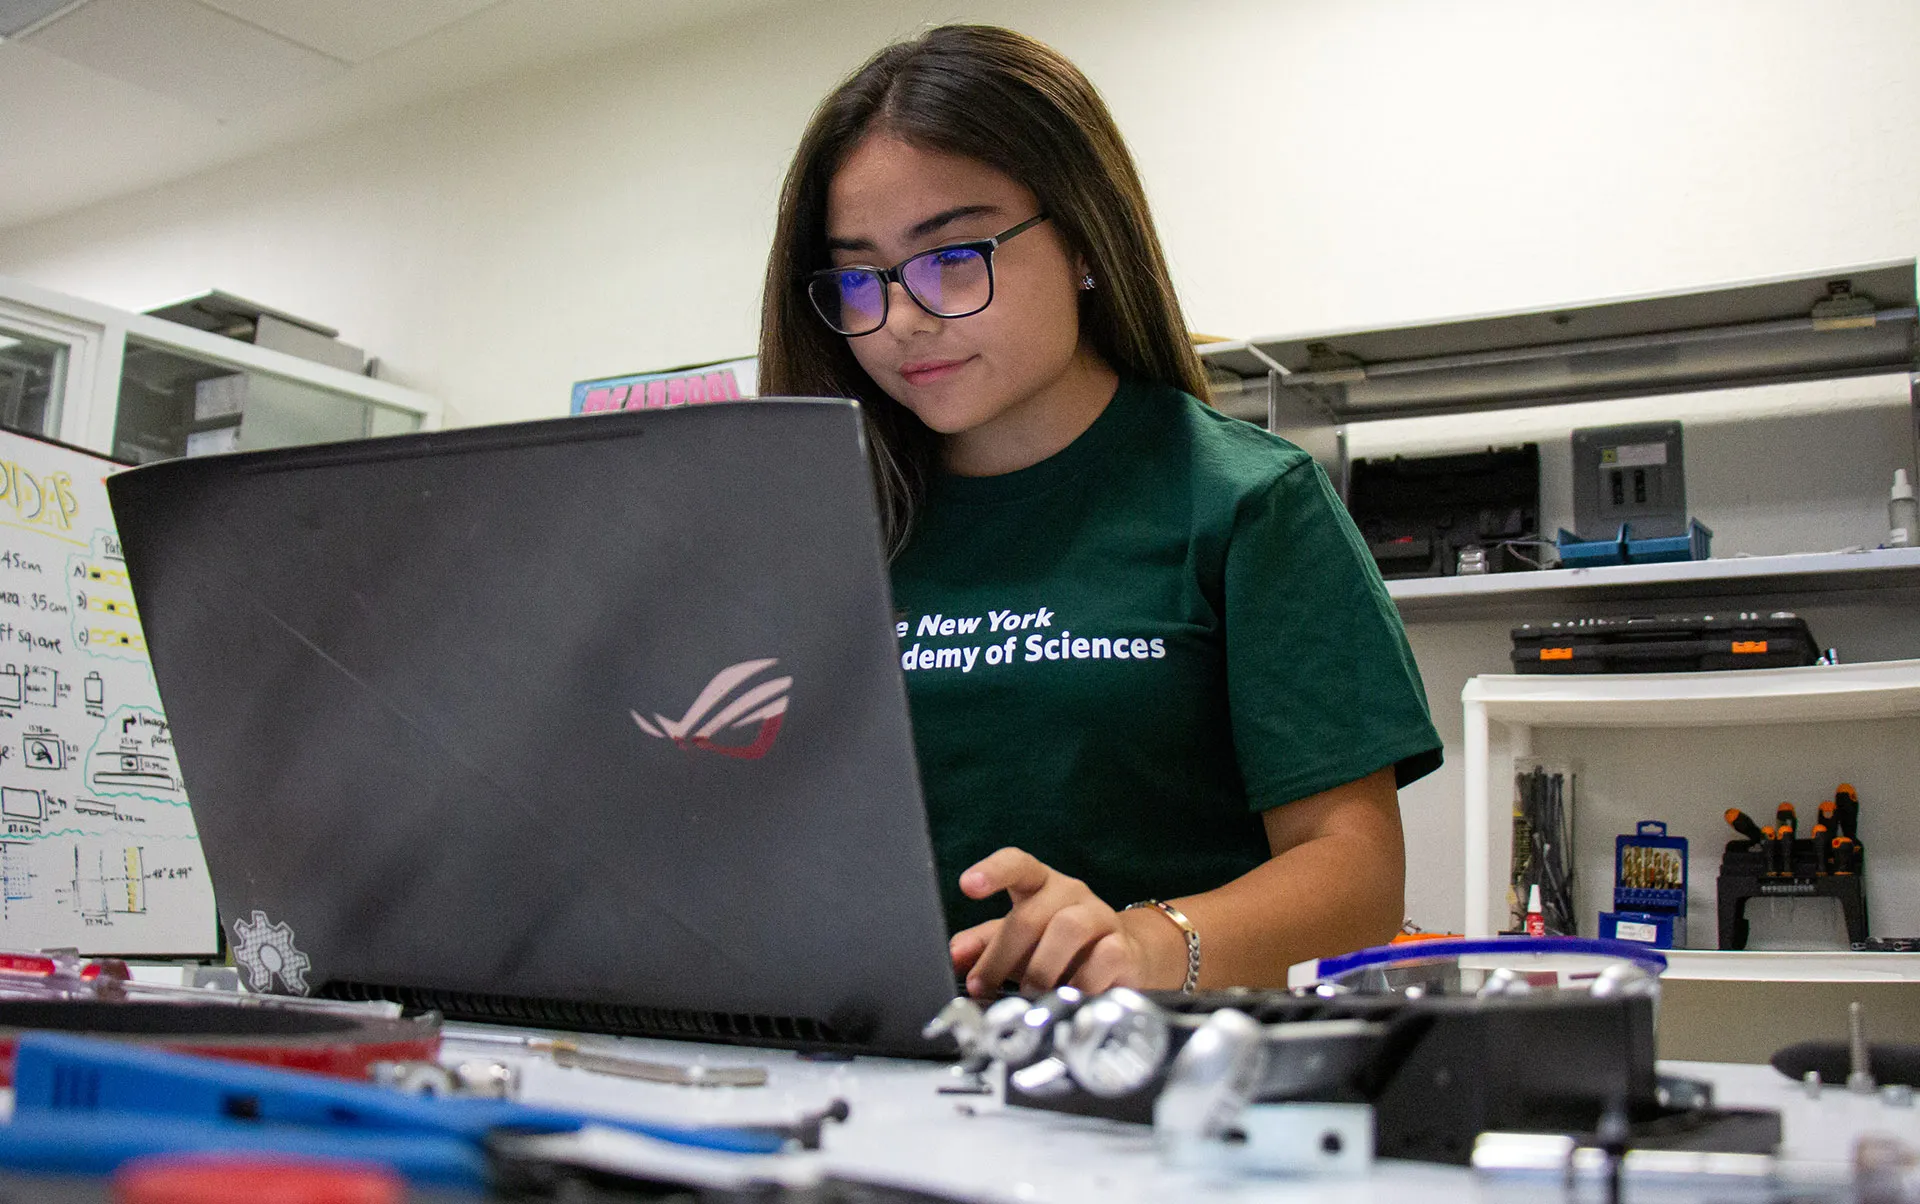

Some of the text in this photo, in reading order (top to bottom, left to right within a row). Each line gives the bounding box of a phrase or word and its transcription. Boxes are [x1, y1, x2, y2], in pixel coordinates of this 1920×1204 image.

[894, 606, 1055, 638] e New York
[901, 630, 1167, 674] demy of Sciences
